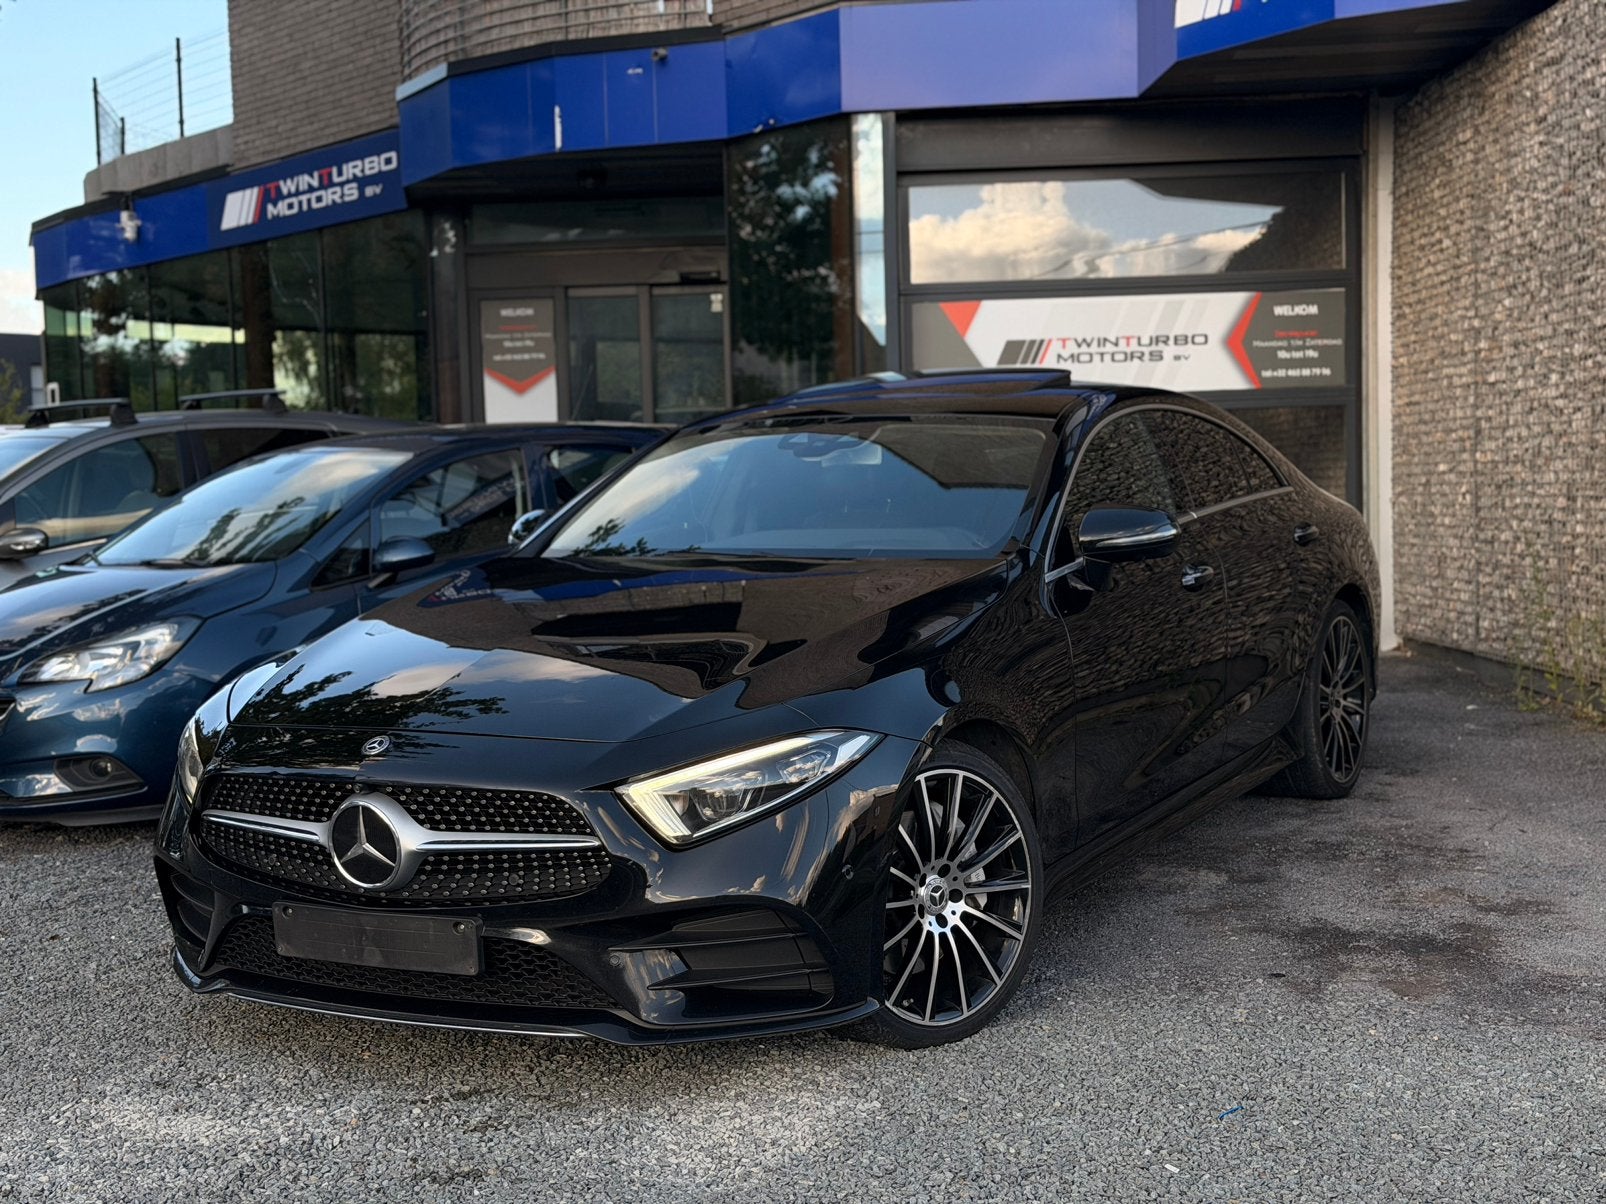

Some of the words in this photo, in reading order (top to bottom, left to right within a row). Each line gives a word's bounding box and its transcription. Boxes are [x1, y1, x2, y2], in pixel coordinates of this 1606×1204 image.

[266, 151, 398, 198] TWINTURBO
[266, 183, 359, 219] MOTORS
[1273, 304, 1318, 316] WELKOM
[1057, 334, 1208, 350] TWINTURBO
[1057, 350, 1164, 364] MOTORS
